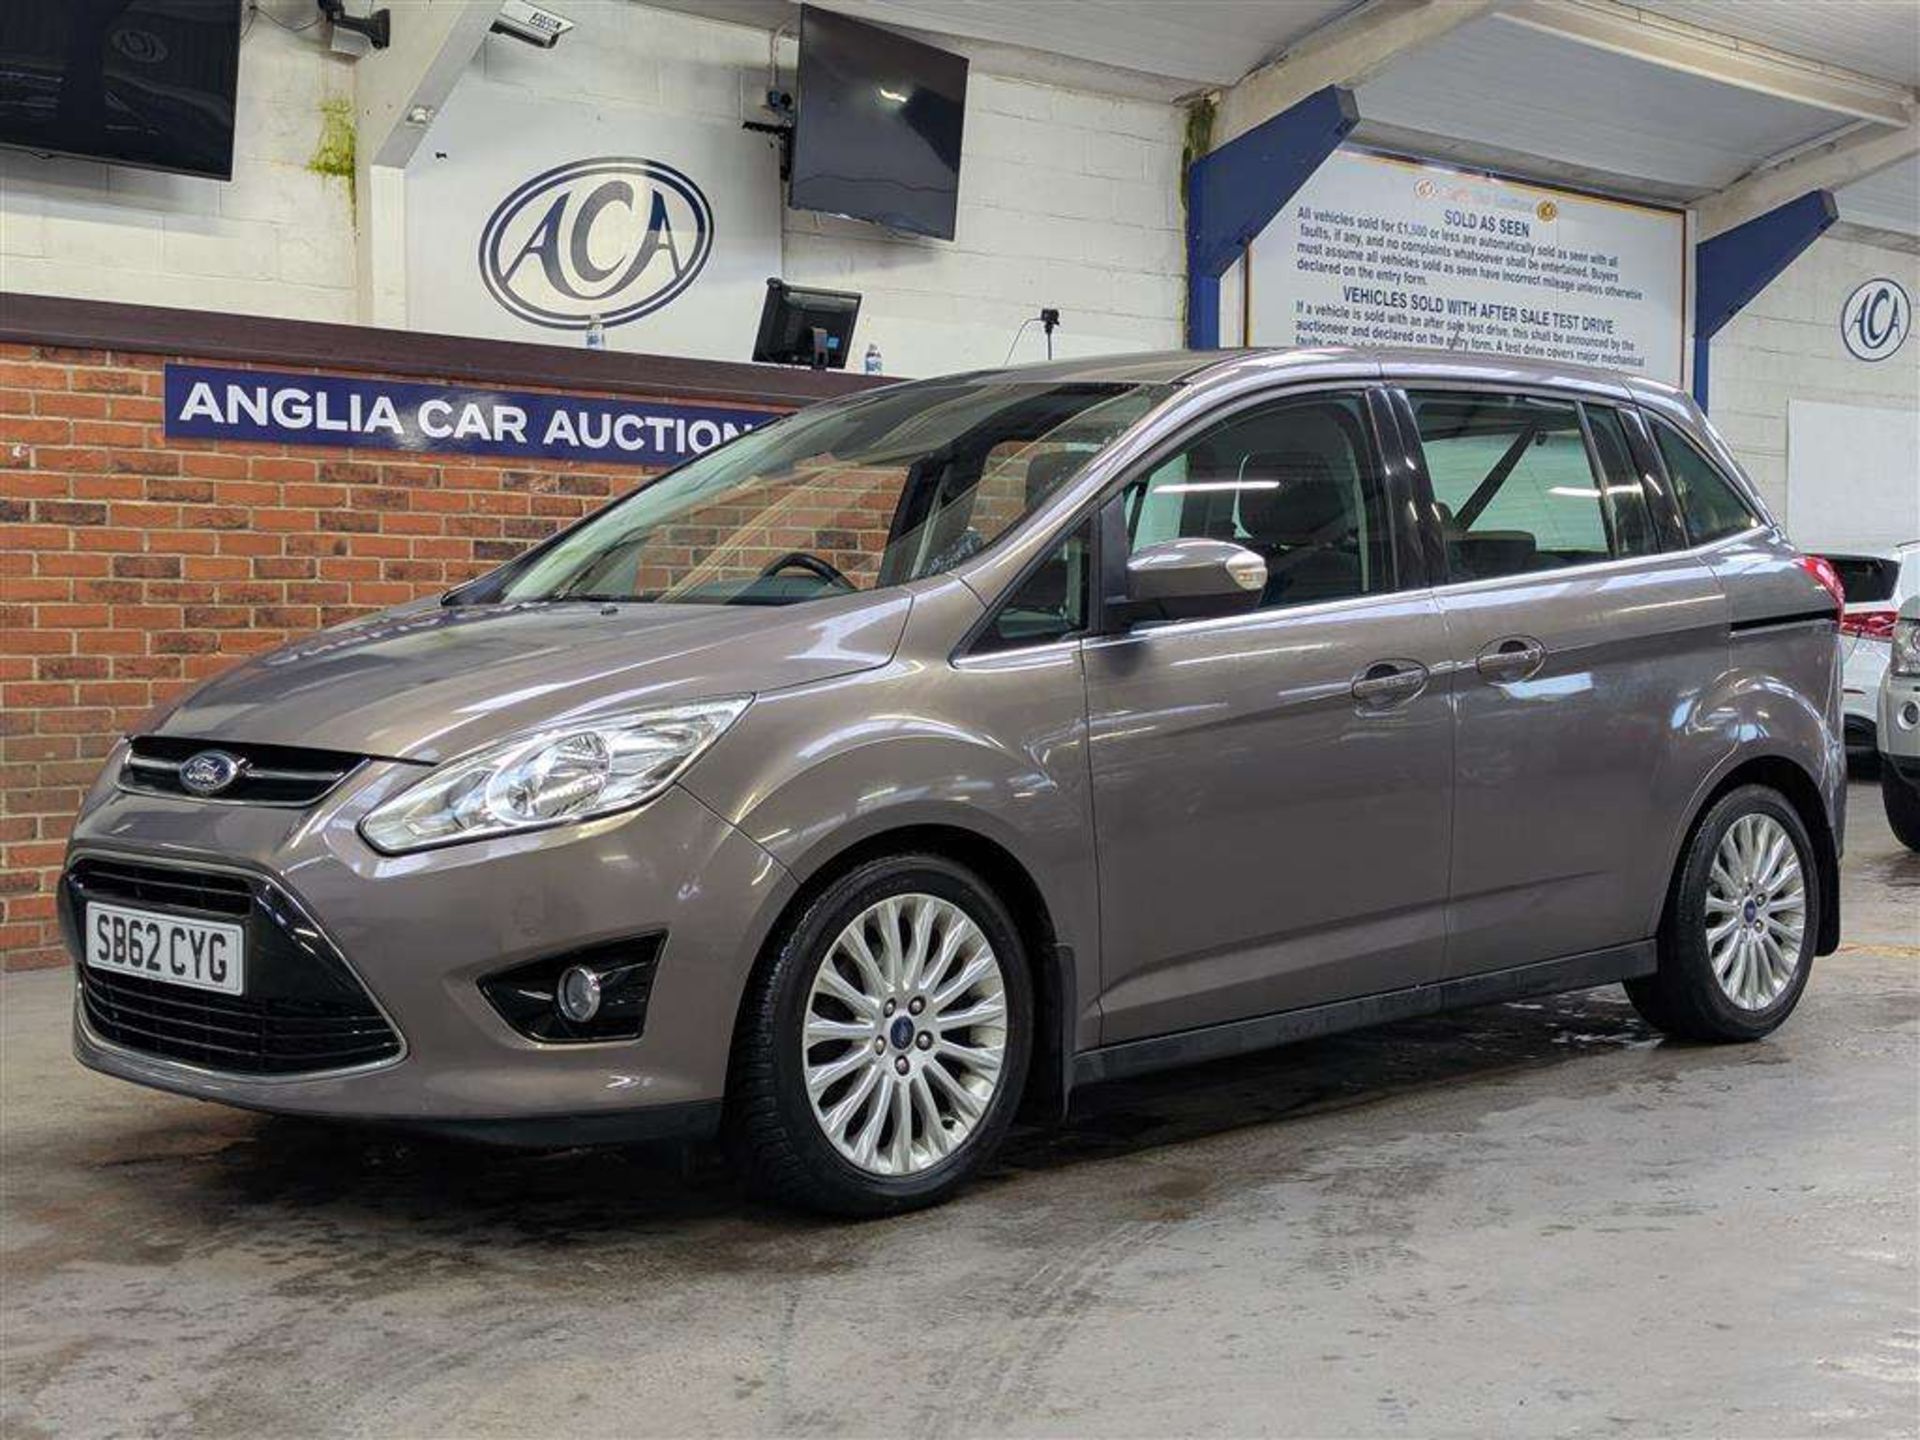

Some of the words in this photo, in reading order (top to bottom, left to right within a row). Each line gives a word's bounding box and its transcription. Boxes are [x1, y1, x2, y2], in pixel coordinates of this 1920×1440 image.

[501, 180, 682, 300] ACA
[1297, 206, 1311, 219] All
[1313, 210, 1354, 227] vehicles
[1357, 217, 1378, 230] sold
[1381, 219, 1395, 233] for
[1429, 228, 1439, 239] or
[1441, 228, 1460, 242] less
[1462, 234, 1477, 245] are
[1479, 237, 1535, 256] automatically
[1537, 245, 1555, 257] sold
[1558, 249, 1568, 260] as
[1569, 251, 1588, 263] seen
[1590, 254, 1606, 265] with
[1444, 209, 1477, 229] SOLD
[1480, 216, 1496, 232] AS
[1499, 218, 1529, 237] SEEN
[1297, 258, 1341, 275] declared
[1343, 265, 1355, 277] on
[1358, 265, 1374, 279] the
[1376, 270, 1401, 285] entry
[1403, 271, 1428, 285] form.
[1297, 243, 1322, 256] must
[1325, 246, 1364, 261] assume
[1366, 250, 1378, 263] all
[1381, 254, 1420, 269] vehicles
[1422, 259, 1441, 272] sold
[1443, 263, 1454, 274] as
[1456, 265, 1477, 277] seen
[1480, 267, 1500, 280] have
[1502, 270, 1541, 285] incorrect
[1542, 276, 1575, 293] mileage
[1577, 282, 1602, 296] unless
[1604, 285, 1643, 301] otherwise
[1301, 223, 1331, 241] faults,
[1334, 228, 1341, 240] if
[1366, 235, 1384, 247] and
[1387, 239, 1399, 250] no
[1401, 240, 1451, 257] complaints
[1454, 249, 1503, 265] whatsoever
[1506, 256, 1526, 268] shall
[1528, 259, 1539, 270] be
[1591, 267, 1619, 283] Buyers
[1296, 300, 1304, 313] If
[1314, 303, 1350, 319] vehicle
[1352, 308, 1361, 320] is
[1364, 310, 1385, 323] sold
[1387, 313, 1407, 325] with
[1410, 316, 1421, 327] an
[1423, 316, 1445, 329] after
[1447, 319, 1465, 332] sale
[1467, 321, 1484, 334] test
[1512, 327, 1528, 339] this
[1531, 329, 1551, 342] shall
[1553, 331, 1564, 343] be
[1566, 333, 1609, 349] announced
[1611, 338, 1621, 352] by
[1621, 339, 1634, 352] the
[1343, 285, 1407, 309] VEHICLES
[1411, 294, 1444, 313] SOLD
[1447, 299, 1477, 317] WITH
[1480, 303, 1518, 322] AFTER
[1520, 308, 1550, 327] SALE
[1552, 312, 1580, 330] TEST
[1582, 316, 1614, 335] DRIVE
[1846, 288, 1901, 349] ACA
[1296, 320, 1348, 335] auctioneer
[1351, 325, 1370, 338] and
[1372, 326, 1414, 342] declared
[1415, 332, 1428, 343] on
[1430, 332, 1444, 345] the
[1496, 340, 1503, 352] A
[1505, 341, 1522, 354] test
[1523, 342, 1545, 356] drive
[1547, 346, 1574, 359] covers
[1576, 351, 1599, 363] major
[1601, 353, 1645, 367] mechanical
[179, 381, 405, 434] ANGLIA
[417, 399, 528, 443] CAR
[97, 913, 161, 972] SB62
[170, 926, 226, 982] CYG
